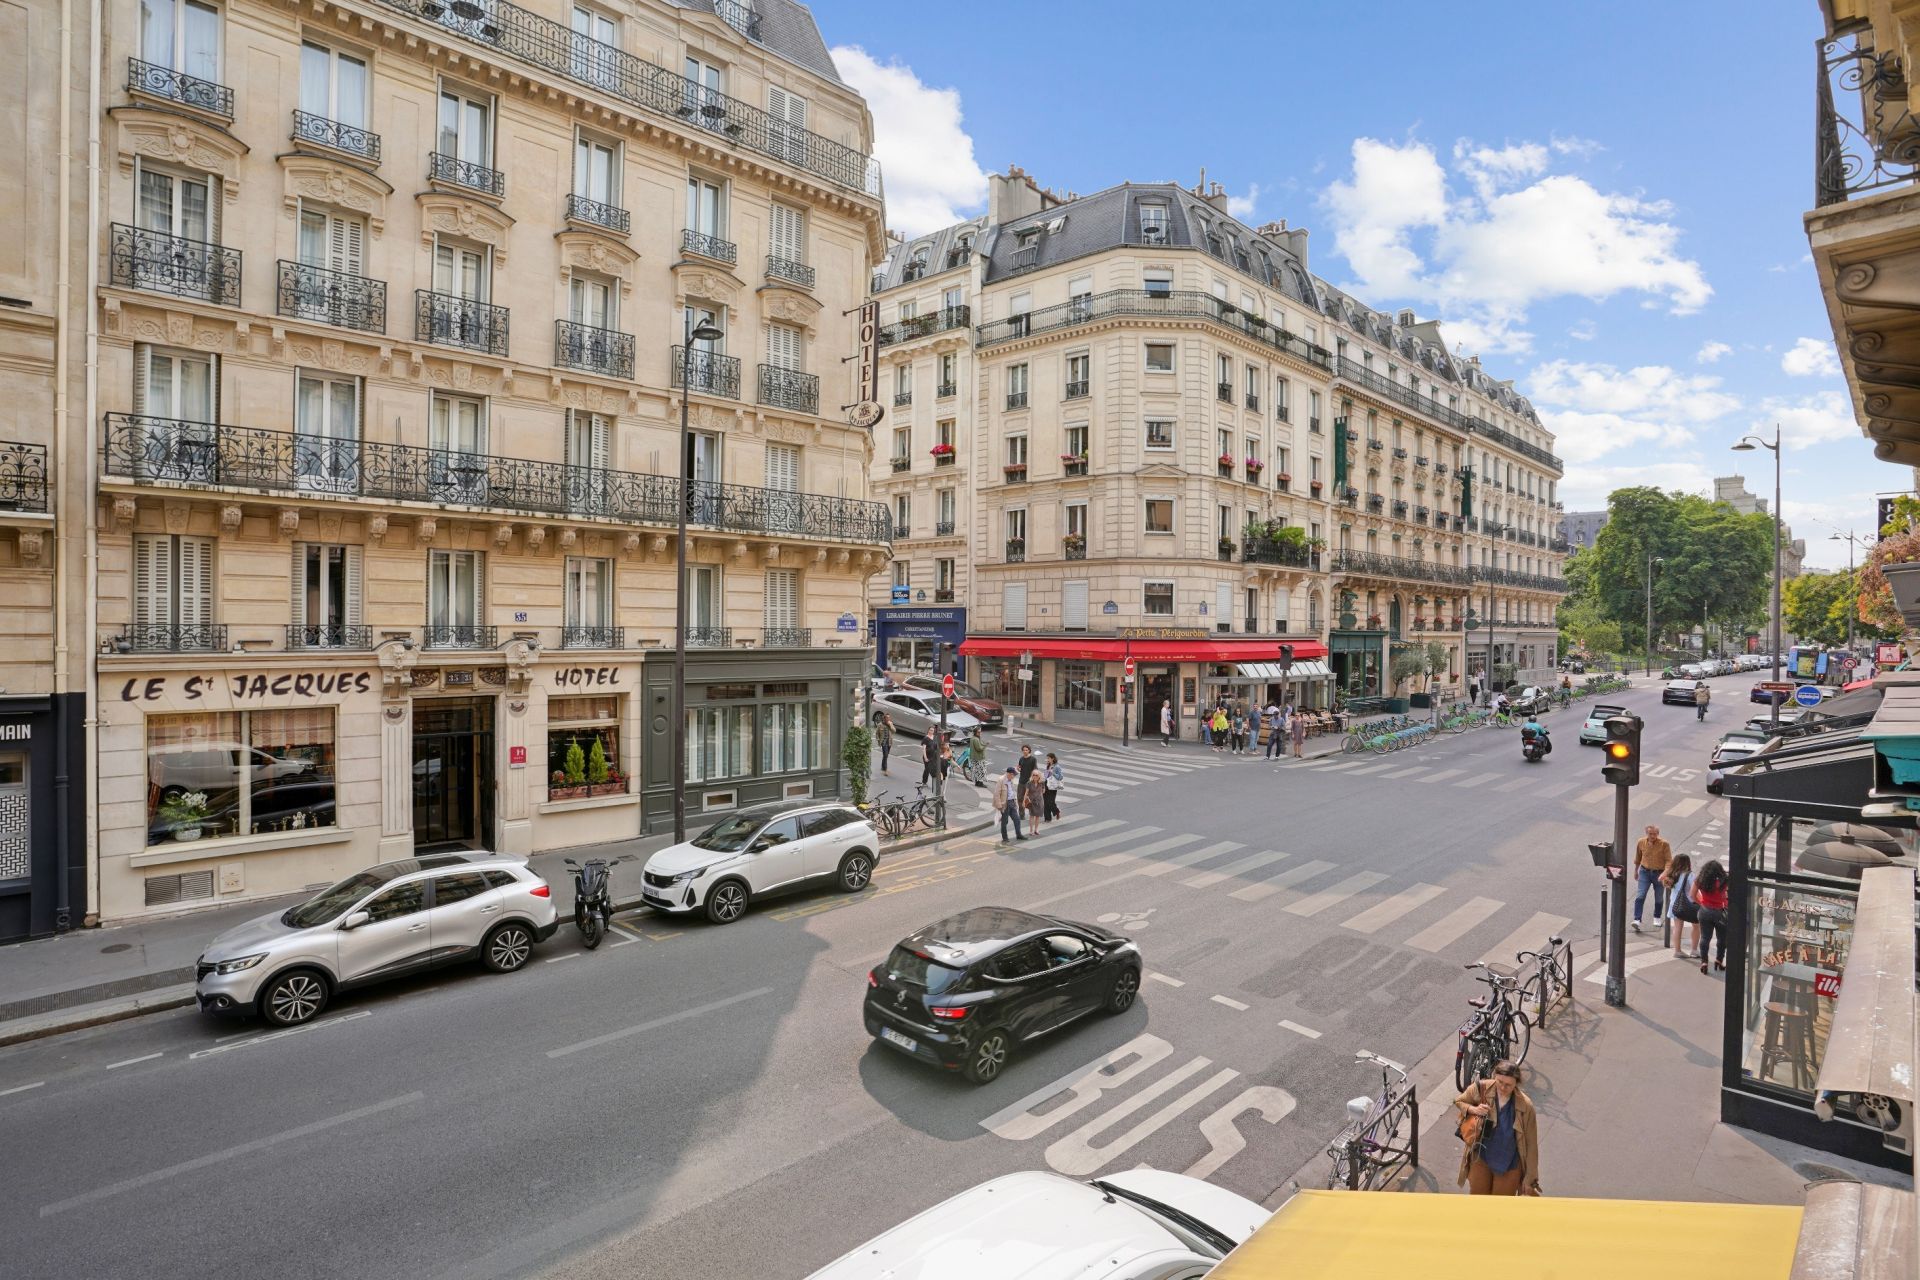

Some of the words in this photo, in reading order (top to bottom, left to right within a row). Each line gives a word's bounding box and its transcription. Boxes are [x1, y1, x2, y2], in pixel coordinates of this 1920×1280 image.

[861, 303, 874, 402] HOTEL
[121, 677, 166, 702] LE
[183, 675, 214, 700] St
[232, 671, 371, 699] JACQUES
[554, 666, 621, 687] HOTEL
[978, 1032, 1298, 1180] BUS
